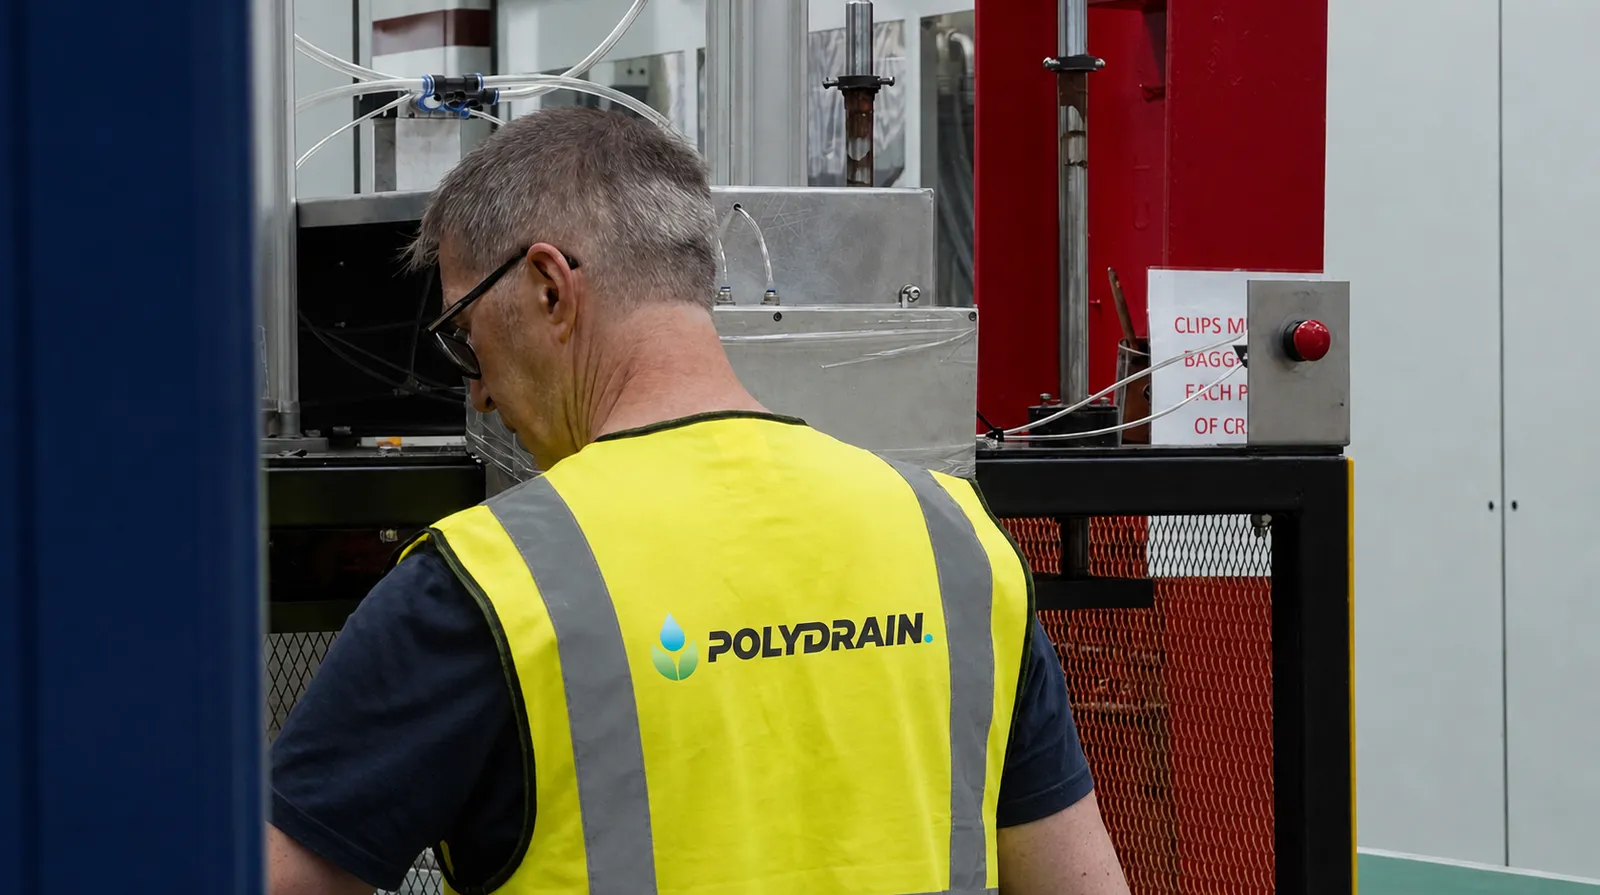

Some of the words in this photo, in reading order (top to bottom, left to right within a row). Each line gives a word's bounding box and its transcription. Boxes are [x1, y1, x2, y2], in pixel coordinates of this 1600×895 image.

[1174, 317, 1222, 334] CLIPS
[1227, 317, 1247, 334] M
[1185, 384, 1232, 401] EACH
[1194, 417, 1218, 435] OF
[1223, 417, 1247, 435] CR
